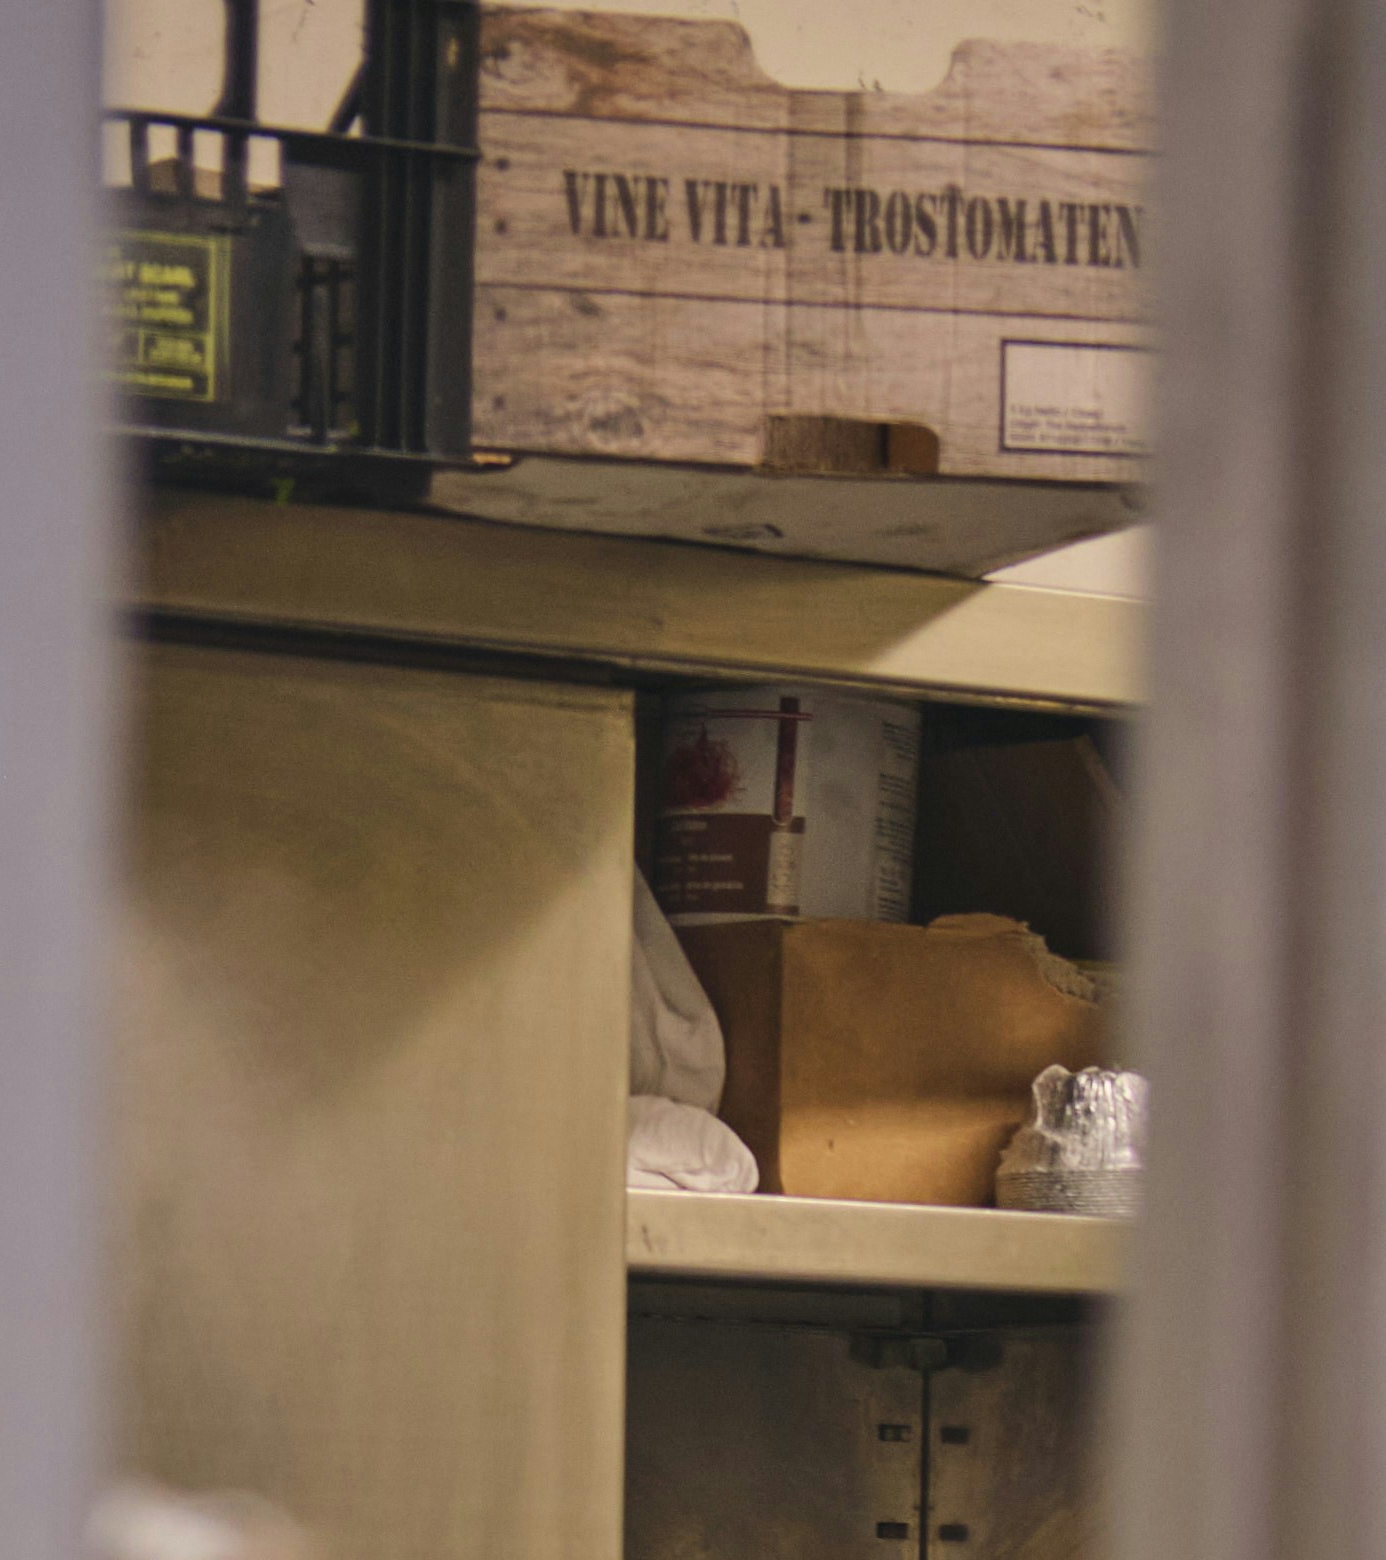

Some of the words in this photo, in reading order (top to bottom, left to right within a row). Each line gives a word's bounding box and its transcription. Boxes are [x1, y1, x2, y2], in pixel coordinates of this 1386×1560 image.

[563, 169, 670, 242] VINE
[683, 178, 787, 249] VITA
[823, 183, 1143, 271] TROSTOMATEN
